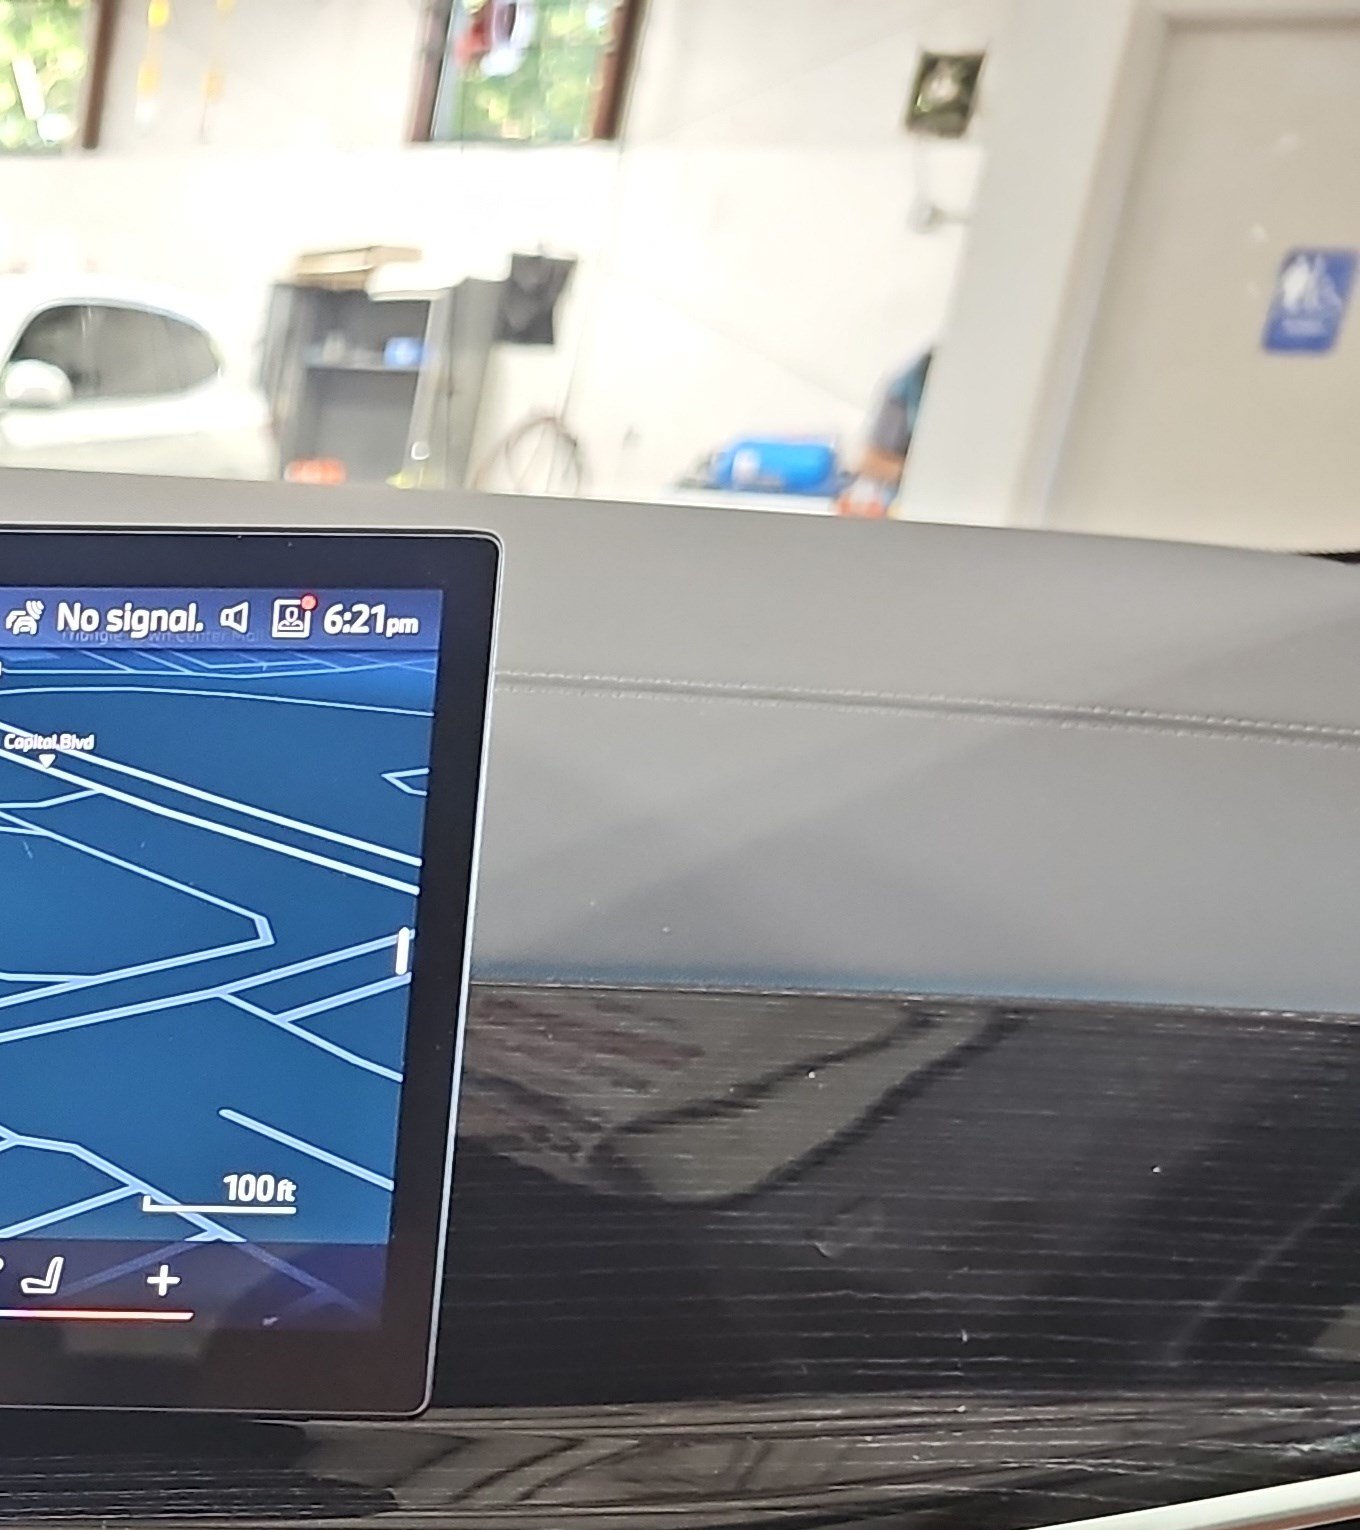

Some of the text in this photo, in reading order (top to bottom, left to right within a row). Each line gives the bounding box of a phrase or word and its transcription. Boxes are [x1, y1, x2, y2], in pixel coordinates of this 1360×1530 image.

[57, 601, 204, 639] No signal.
[323, 602, 419, 637] 6:21pm
[4, 733, 95, 751] Capital Blvd
[223, 1174, 274, 1203] 100
